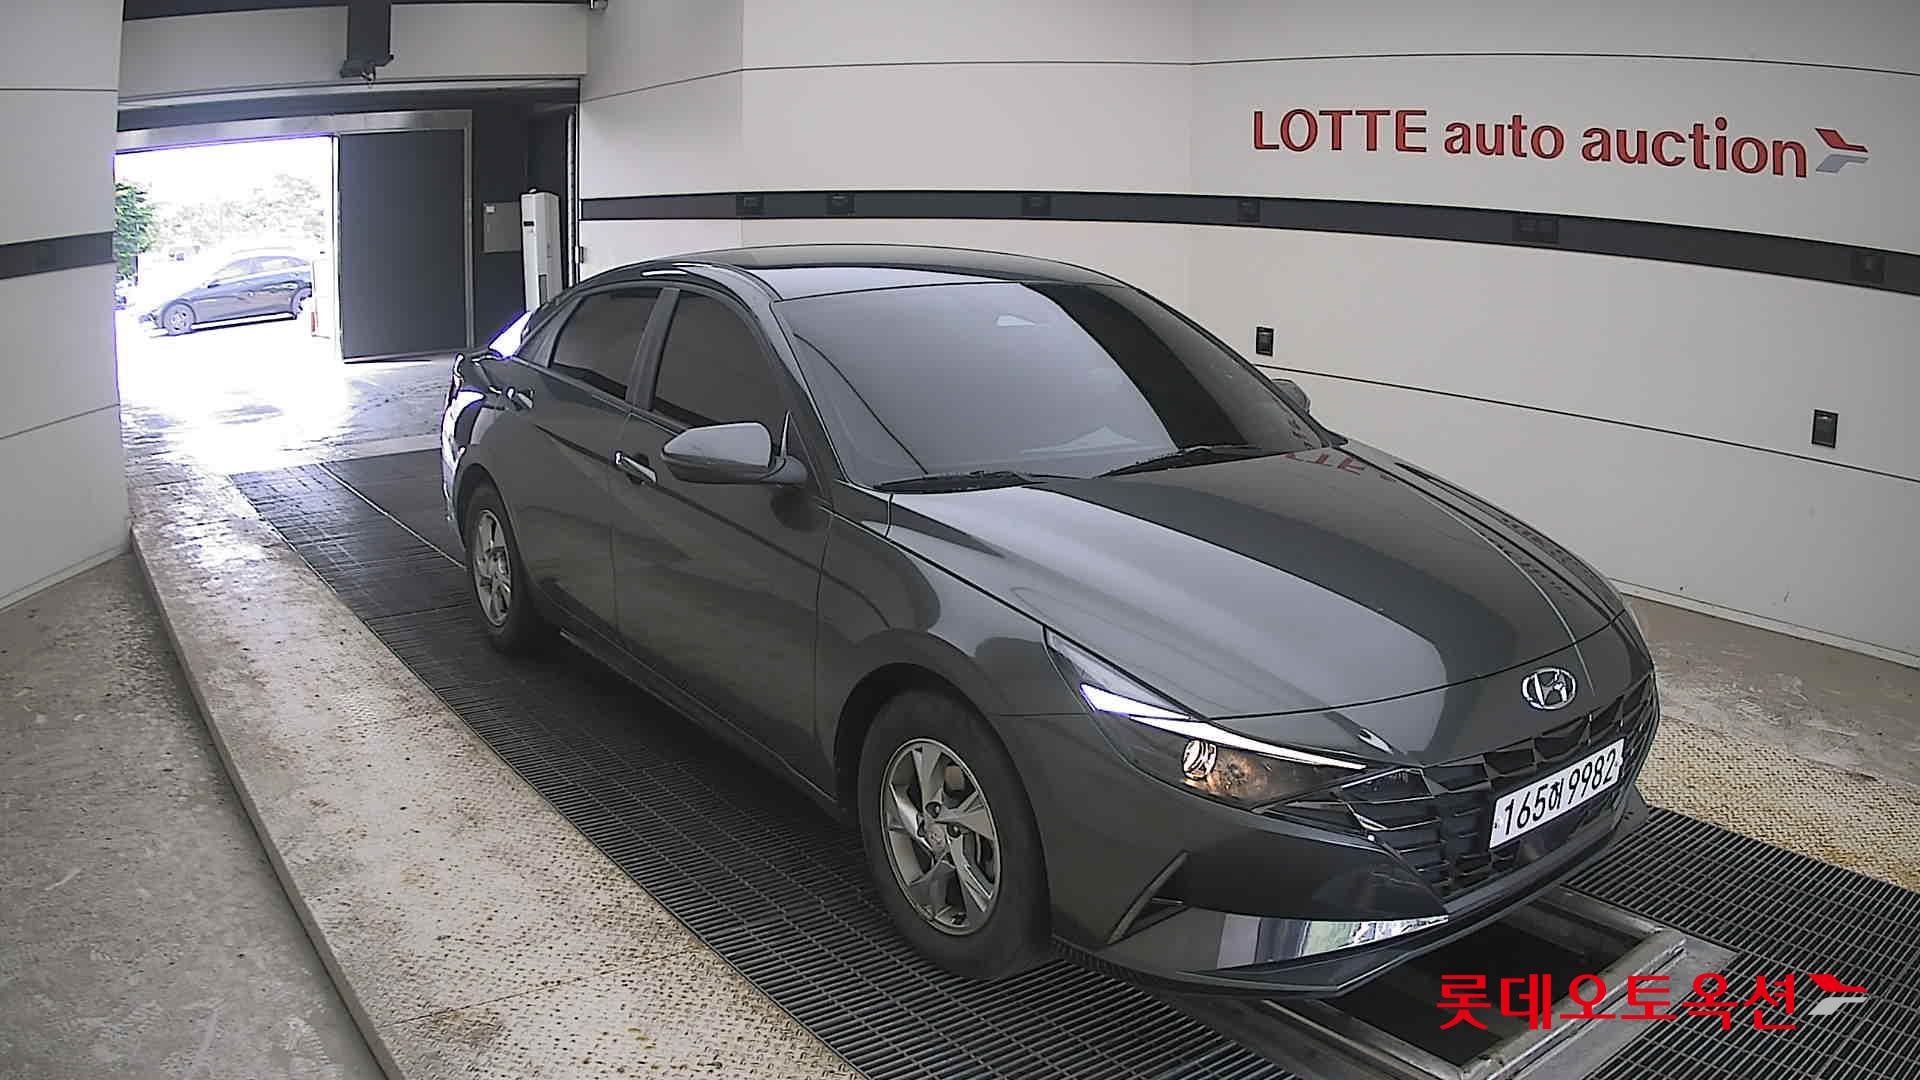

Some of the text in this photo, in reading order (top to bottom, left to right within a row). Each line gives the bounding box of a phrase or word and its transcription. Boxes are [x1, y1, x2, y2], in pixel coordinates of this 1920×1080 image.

[1253, 109, 1807, 178] LOTTE auto auction
